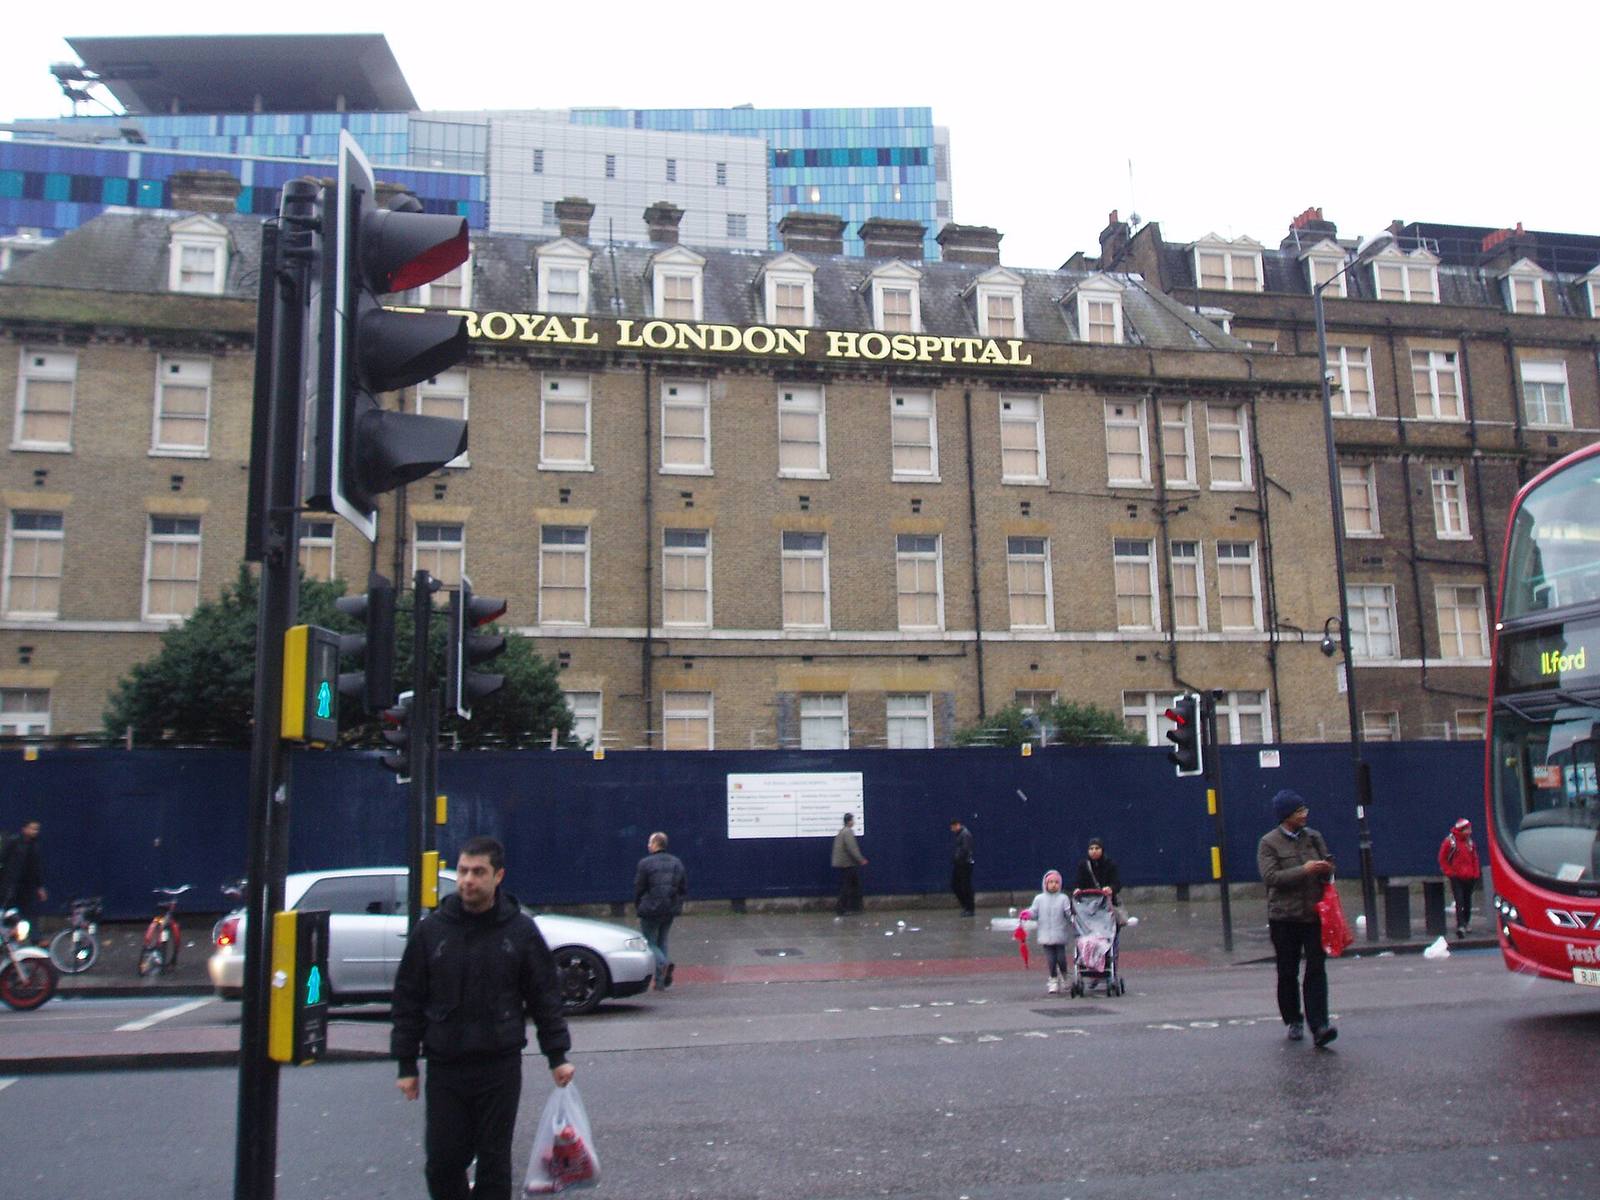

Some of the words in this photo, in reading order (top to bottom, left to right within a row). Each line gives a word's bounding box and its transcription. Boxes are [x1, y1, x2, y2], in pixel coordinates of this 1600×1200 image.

[616, 319, 809, 354] LONDON
[826, 331, 1032, 365] HOSPITAL
[1541, 646, 1585, 675] Ilford
